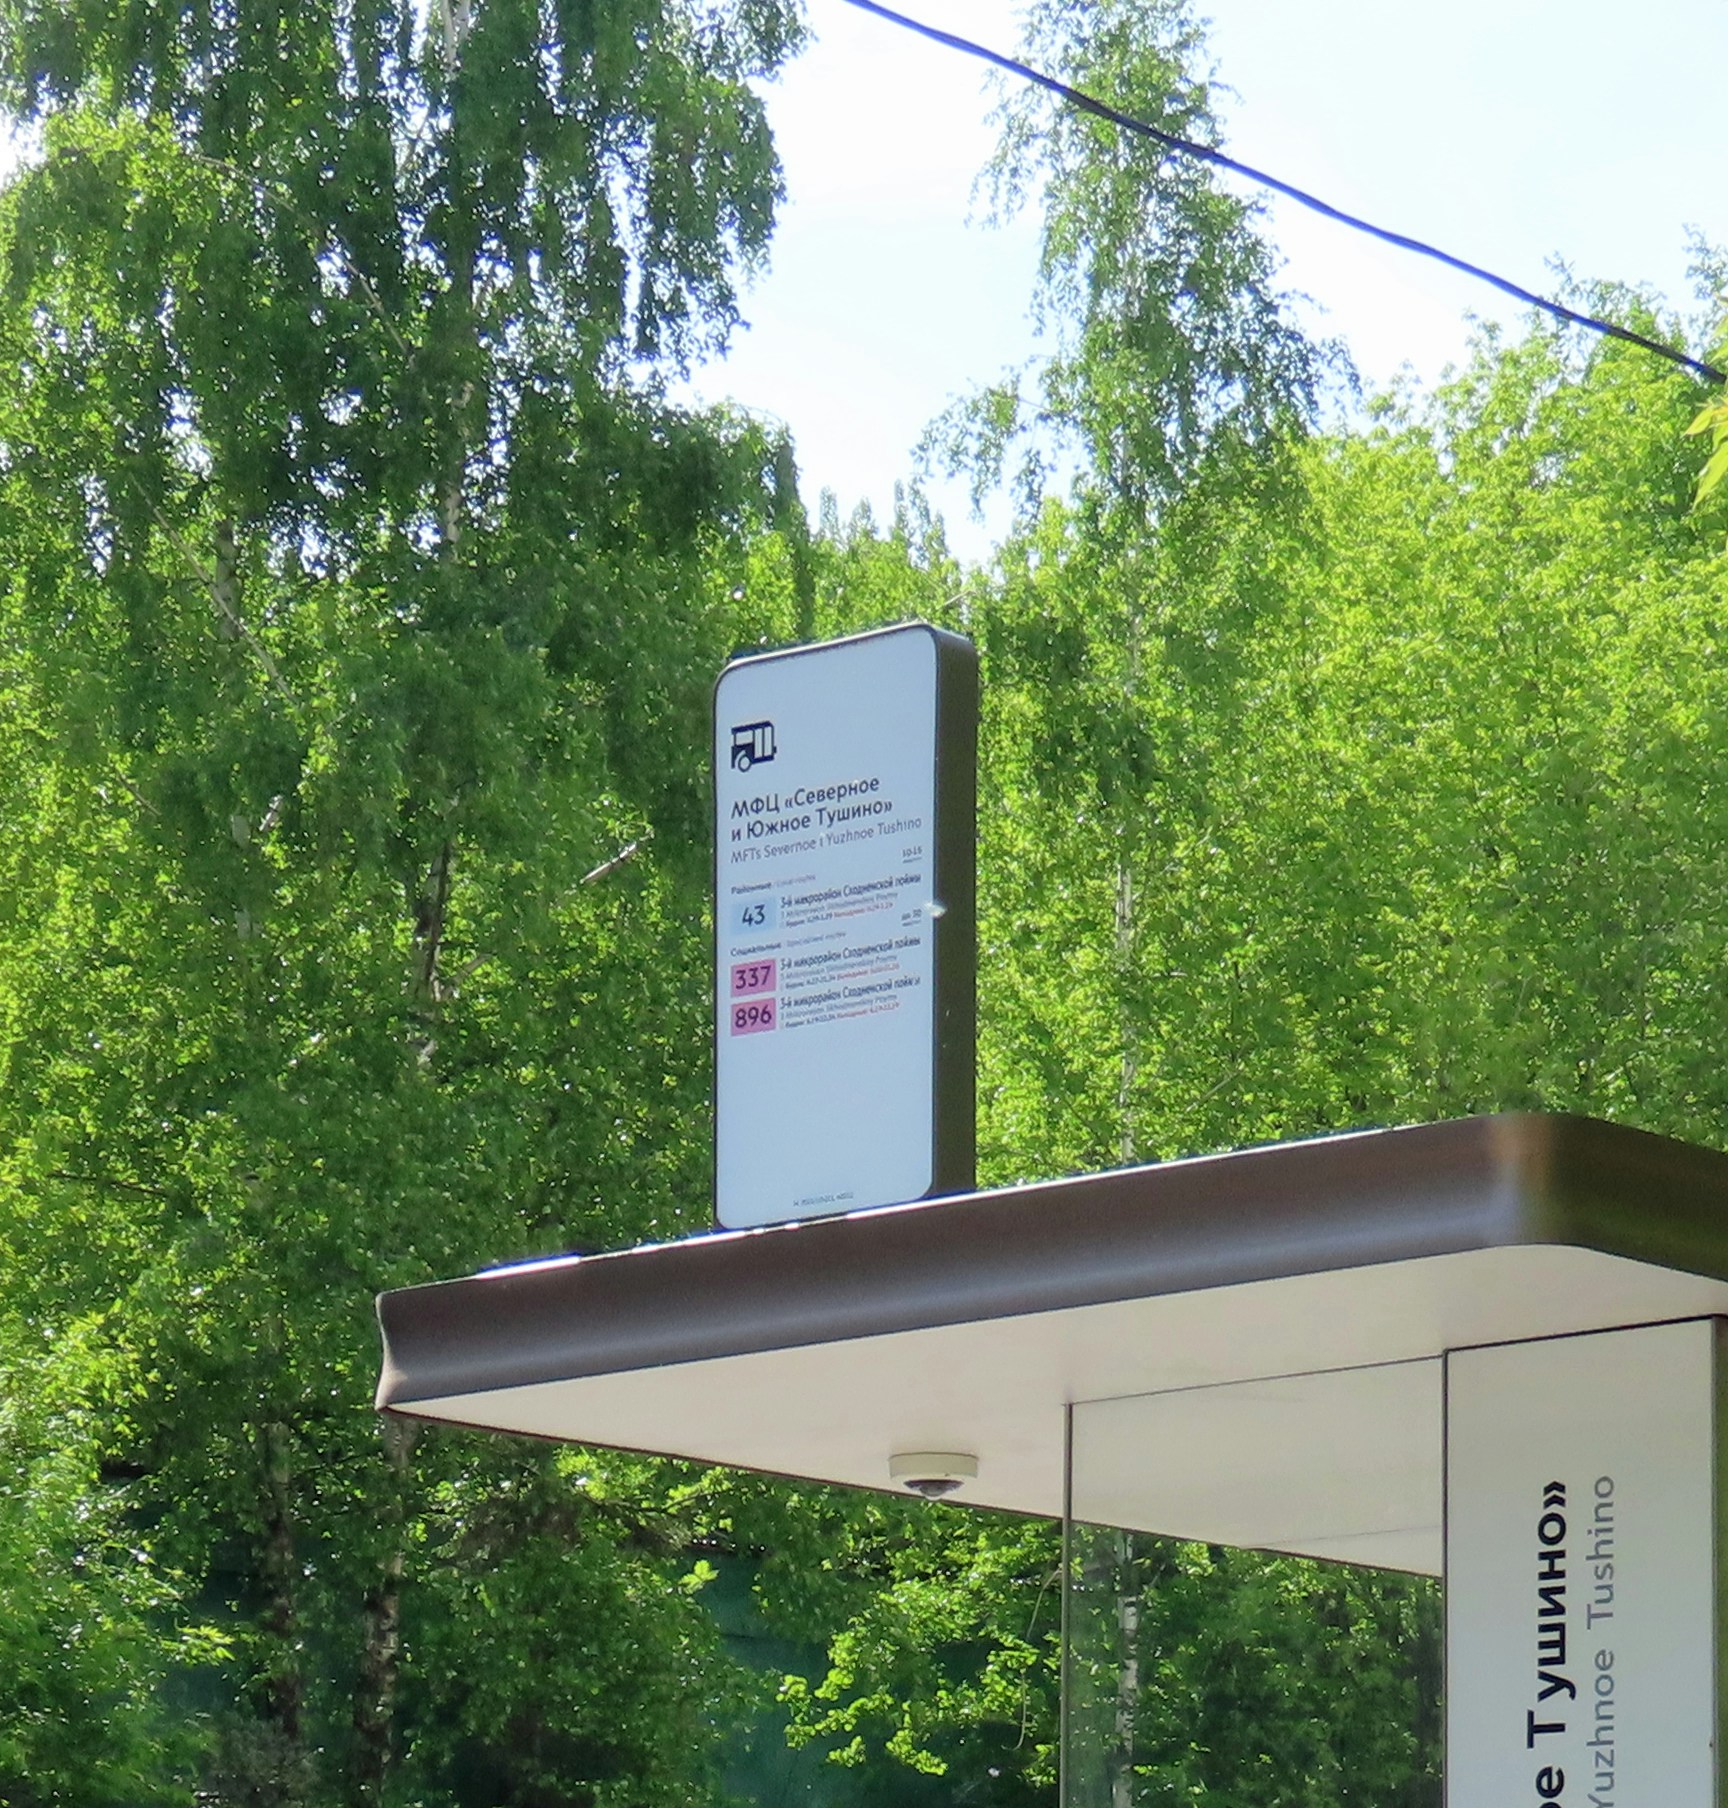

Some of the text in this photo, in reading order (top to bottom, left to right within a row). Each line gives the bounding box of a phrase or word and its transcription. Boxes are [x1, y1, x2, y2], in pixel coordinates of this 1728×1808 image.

[730, 777, 880, 820] МФЦ «Северное
[730, 846, 761, 864] MFTs
[763, 837, 817, 861] Severnoe
[826, 827, 874, 849] Yuzhnoe
[877, 816, 922, 837] Tushino
[731, 800, 893, 843] и Южное Тушино»
[742, 904, 766, 927] 43
[735, 965, 772, 989] 337
[735, 1003, 773, 1028] 896
[1584, 1475, 1616, 1631] Tushino
[1526, 1481, 1577, 1749] Тушино»
